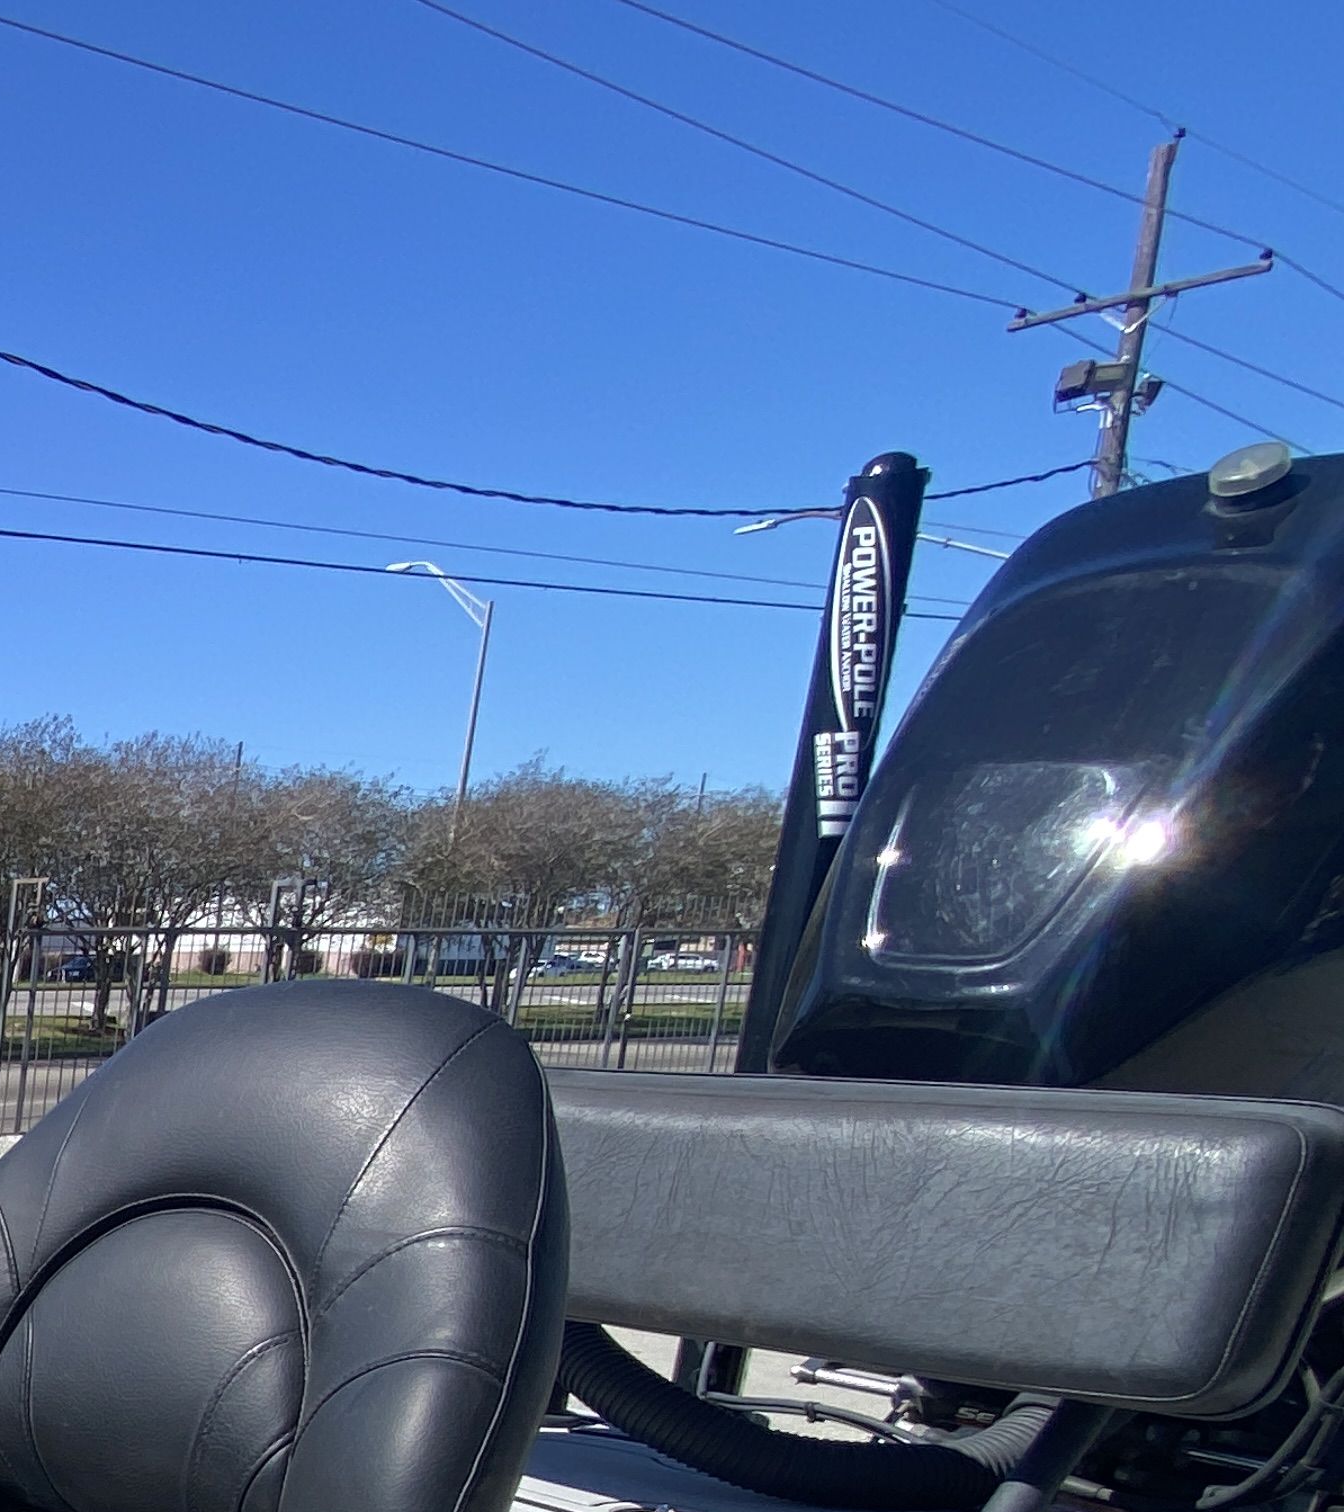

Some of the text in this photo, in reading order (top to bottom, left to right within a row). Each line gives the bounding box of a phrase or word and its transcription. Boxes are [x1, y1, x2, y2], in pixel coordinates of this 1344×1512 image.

[852, 526, 877, 719] POWER-POLE
[815, 732, 834, 797] SERIES
[835, 731, 859, 797] PRO
